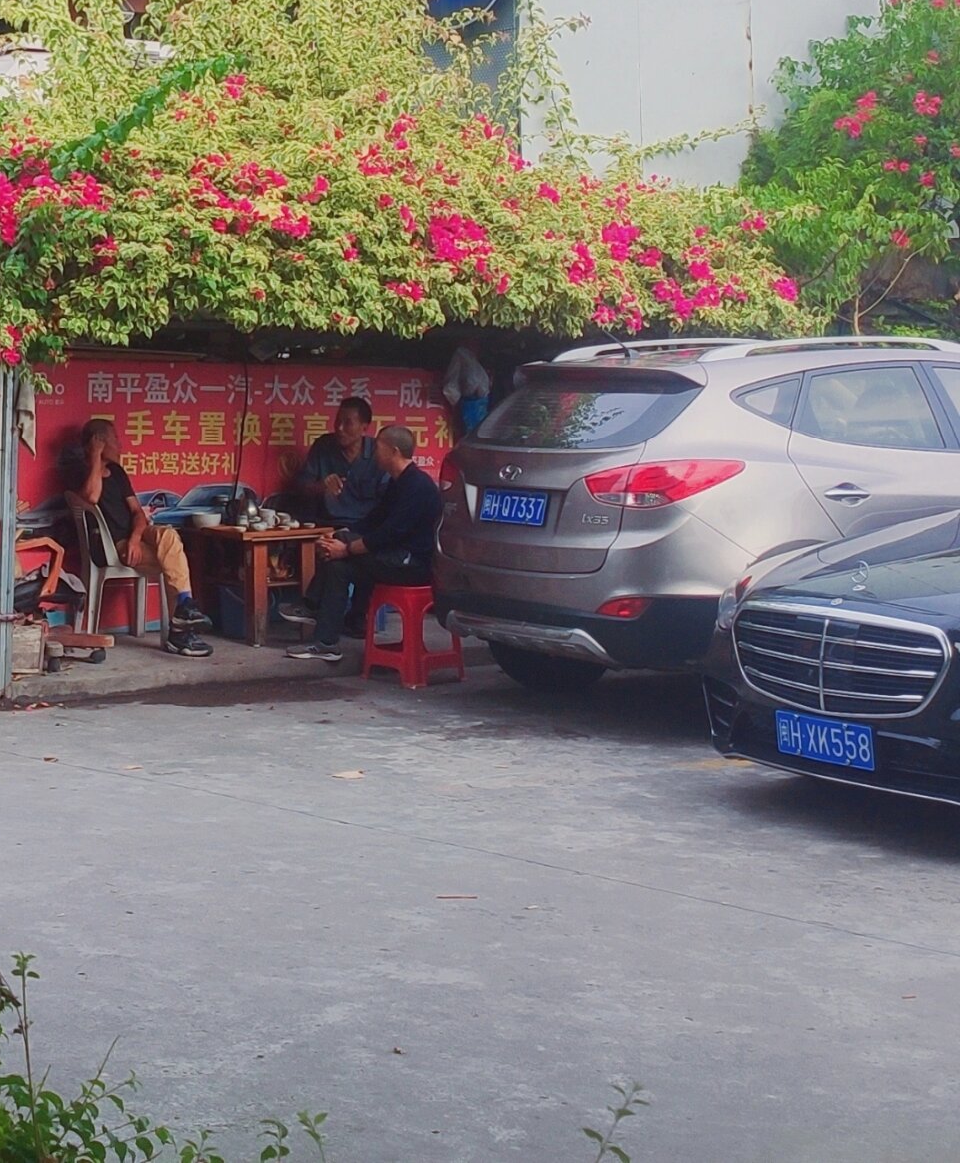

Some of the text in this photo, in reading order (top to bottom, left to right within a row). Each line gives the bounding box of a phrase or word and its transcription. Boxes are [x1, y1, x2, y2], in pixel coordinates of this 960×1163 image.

[87, 371, 314, 406] 南平盈众一汽-大众
